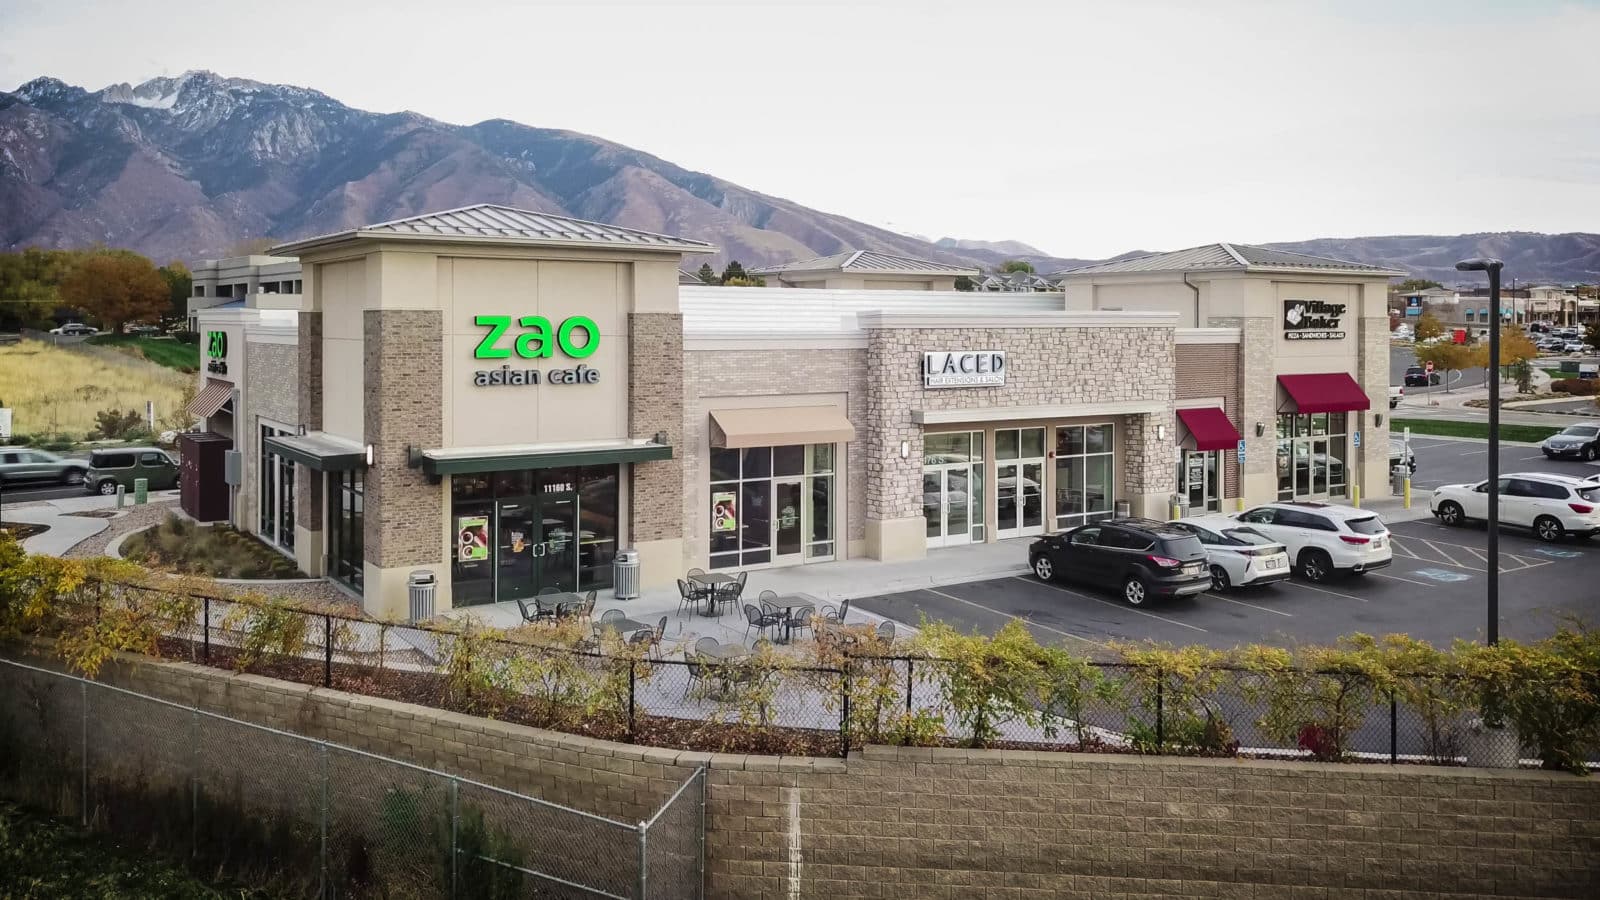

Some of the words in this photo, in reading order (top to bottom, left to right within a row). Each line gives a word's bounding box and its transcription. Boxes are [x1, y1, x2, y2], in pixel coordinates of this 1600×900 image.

[1304, 300, 1346, 317] Village
[927, 353, 1003, 374] LACED
[474, 365, 541, 386] asian
[548, 364, 600, 384] cafe
